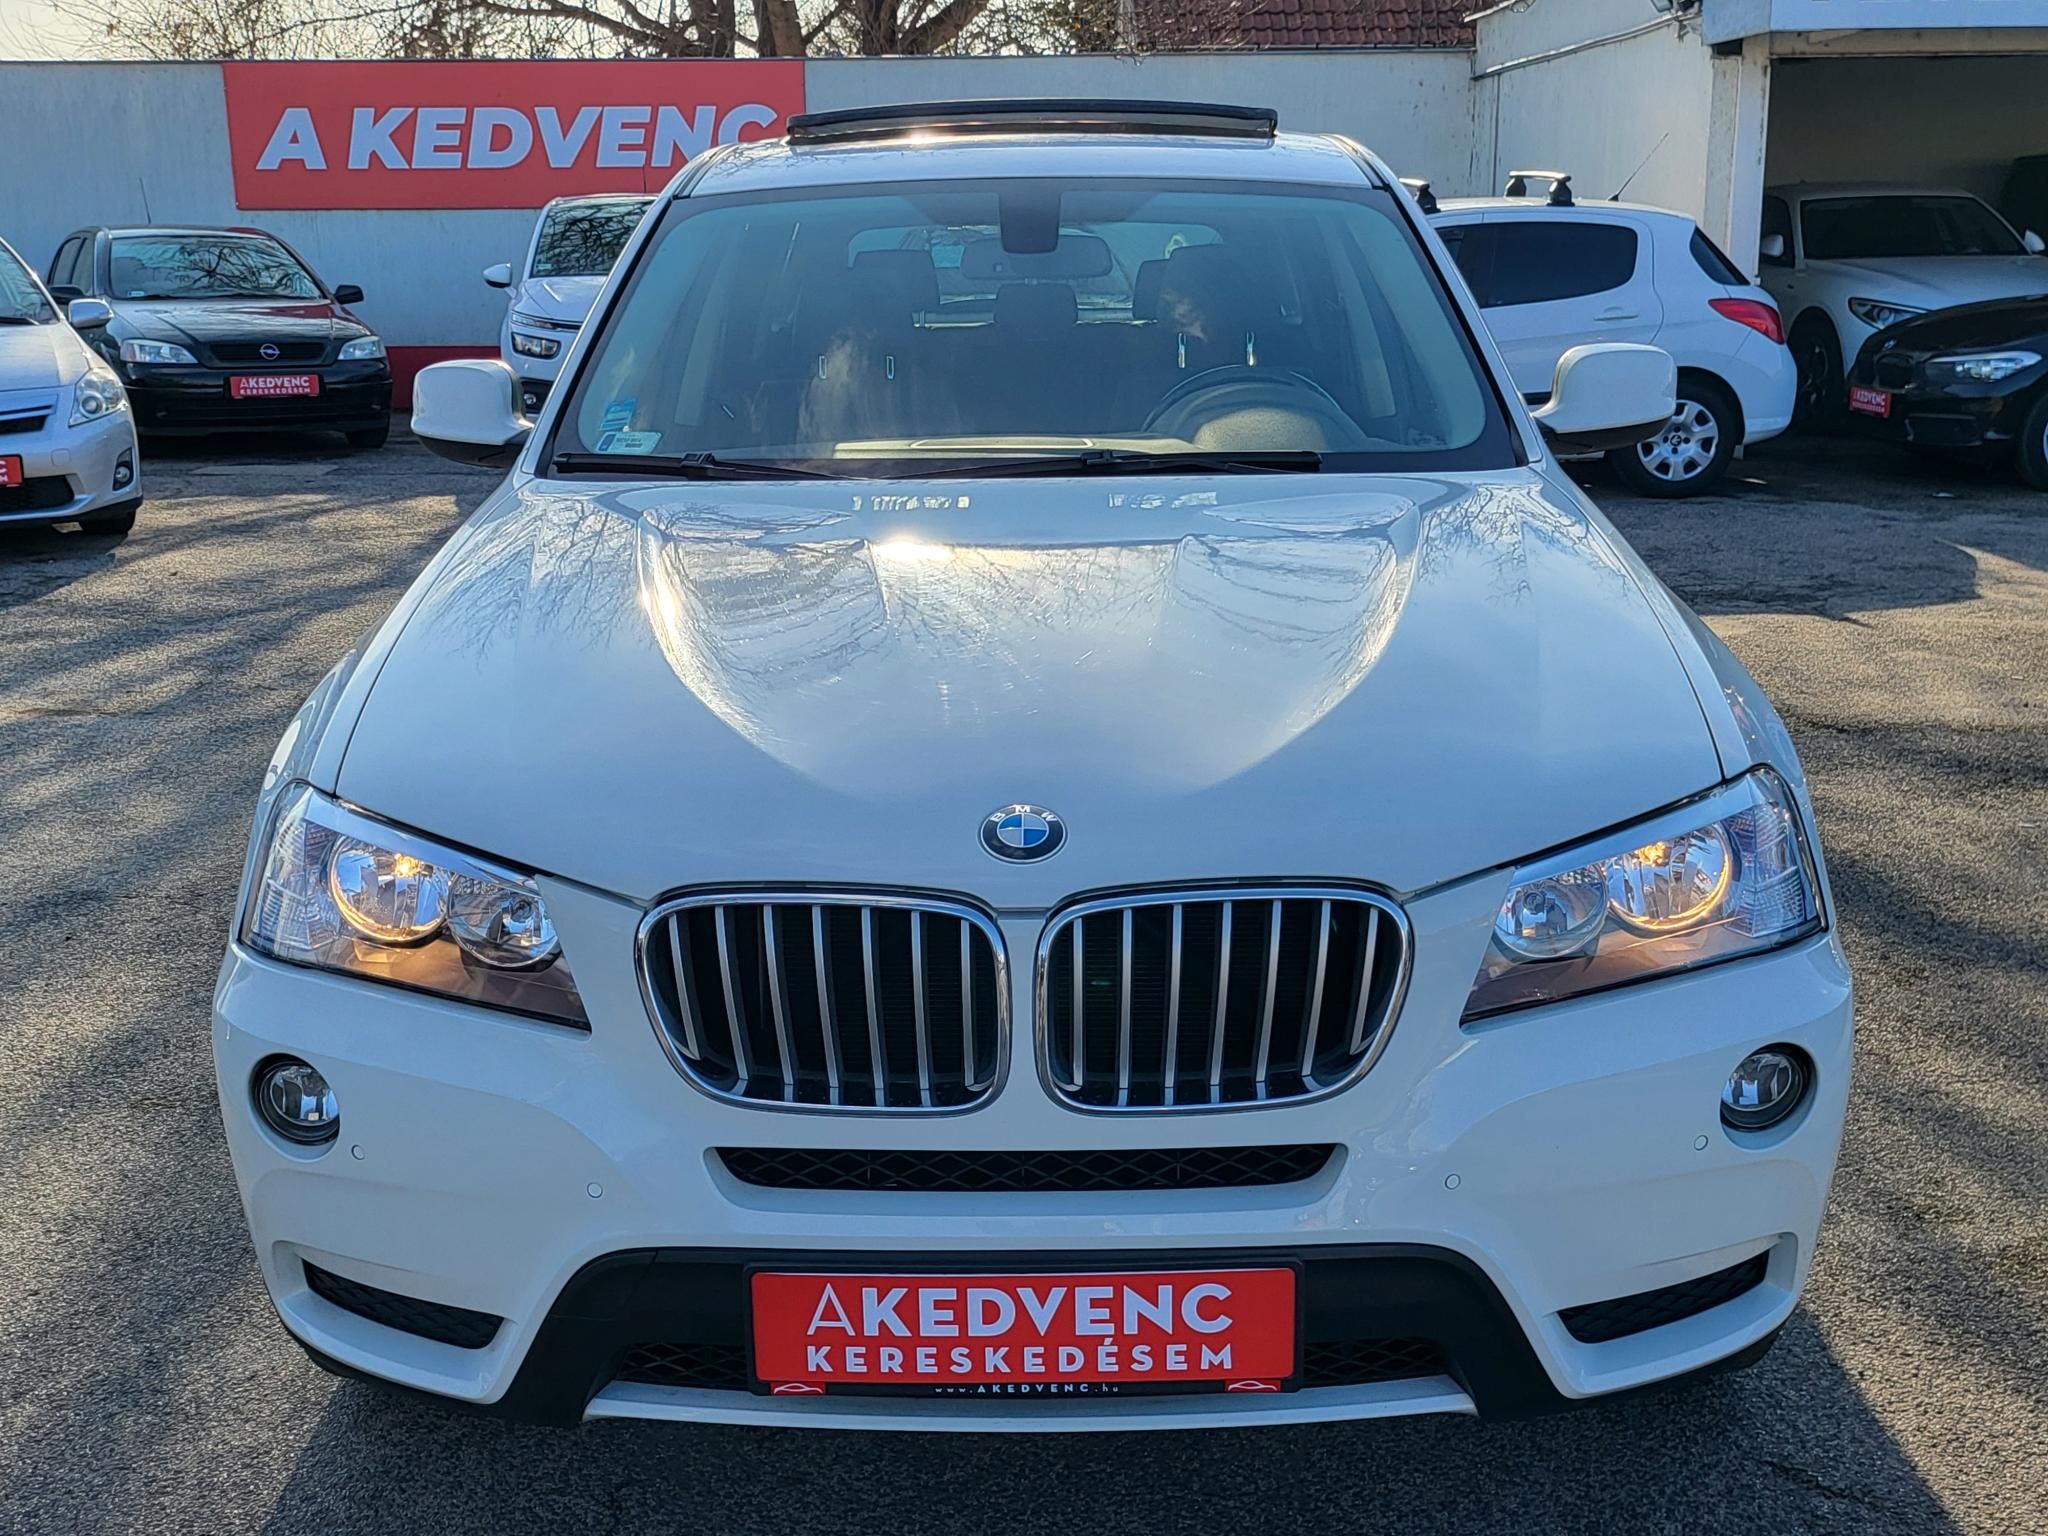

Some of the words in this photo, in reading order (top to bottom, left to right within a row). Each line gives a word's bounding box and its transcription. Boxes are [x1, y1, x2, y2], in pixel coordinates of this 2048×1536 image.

[255, 107, 328, 170] A
[346, 104, 778, 169] KEDVENC
[990, 805, 1058, 822] BMW
[806, 1338, 1232, 1373] KERESKEDÉSEM
[935, 1383, 1119, 1393] www.AKEDVENC.hu
